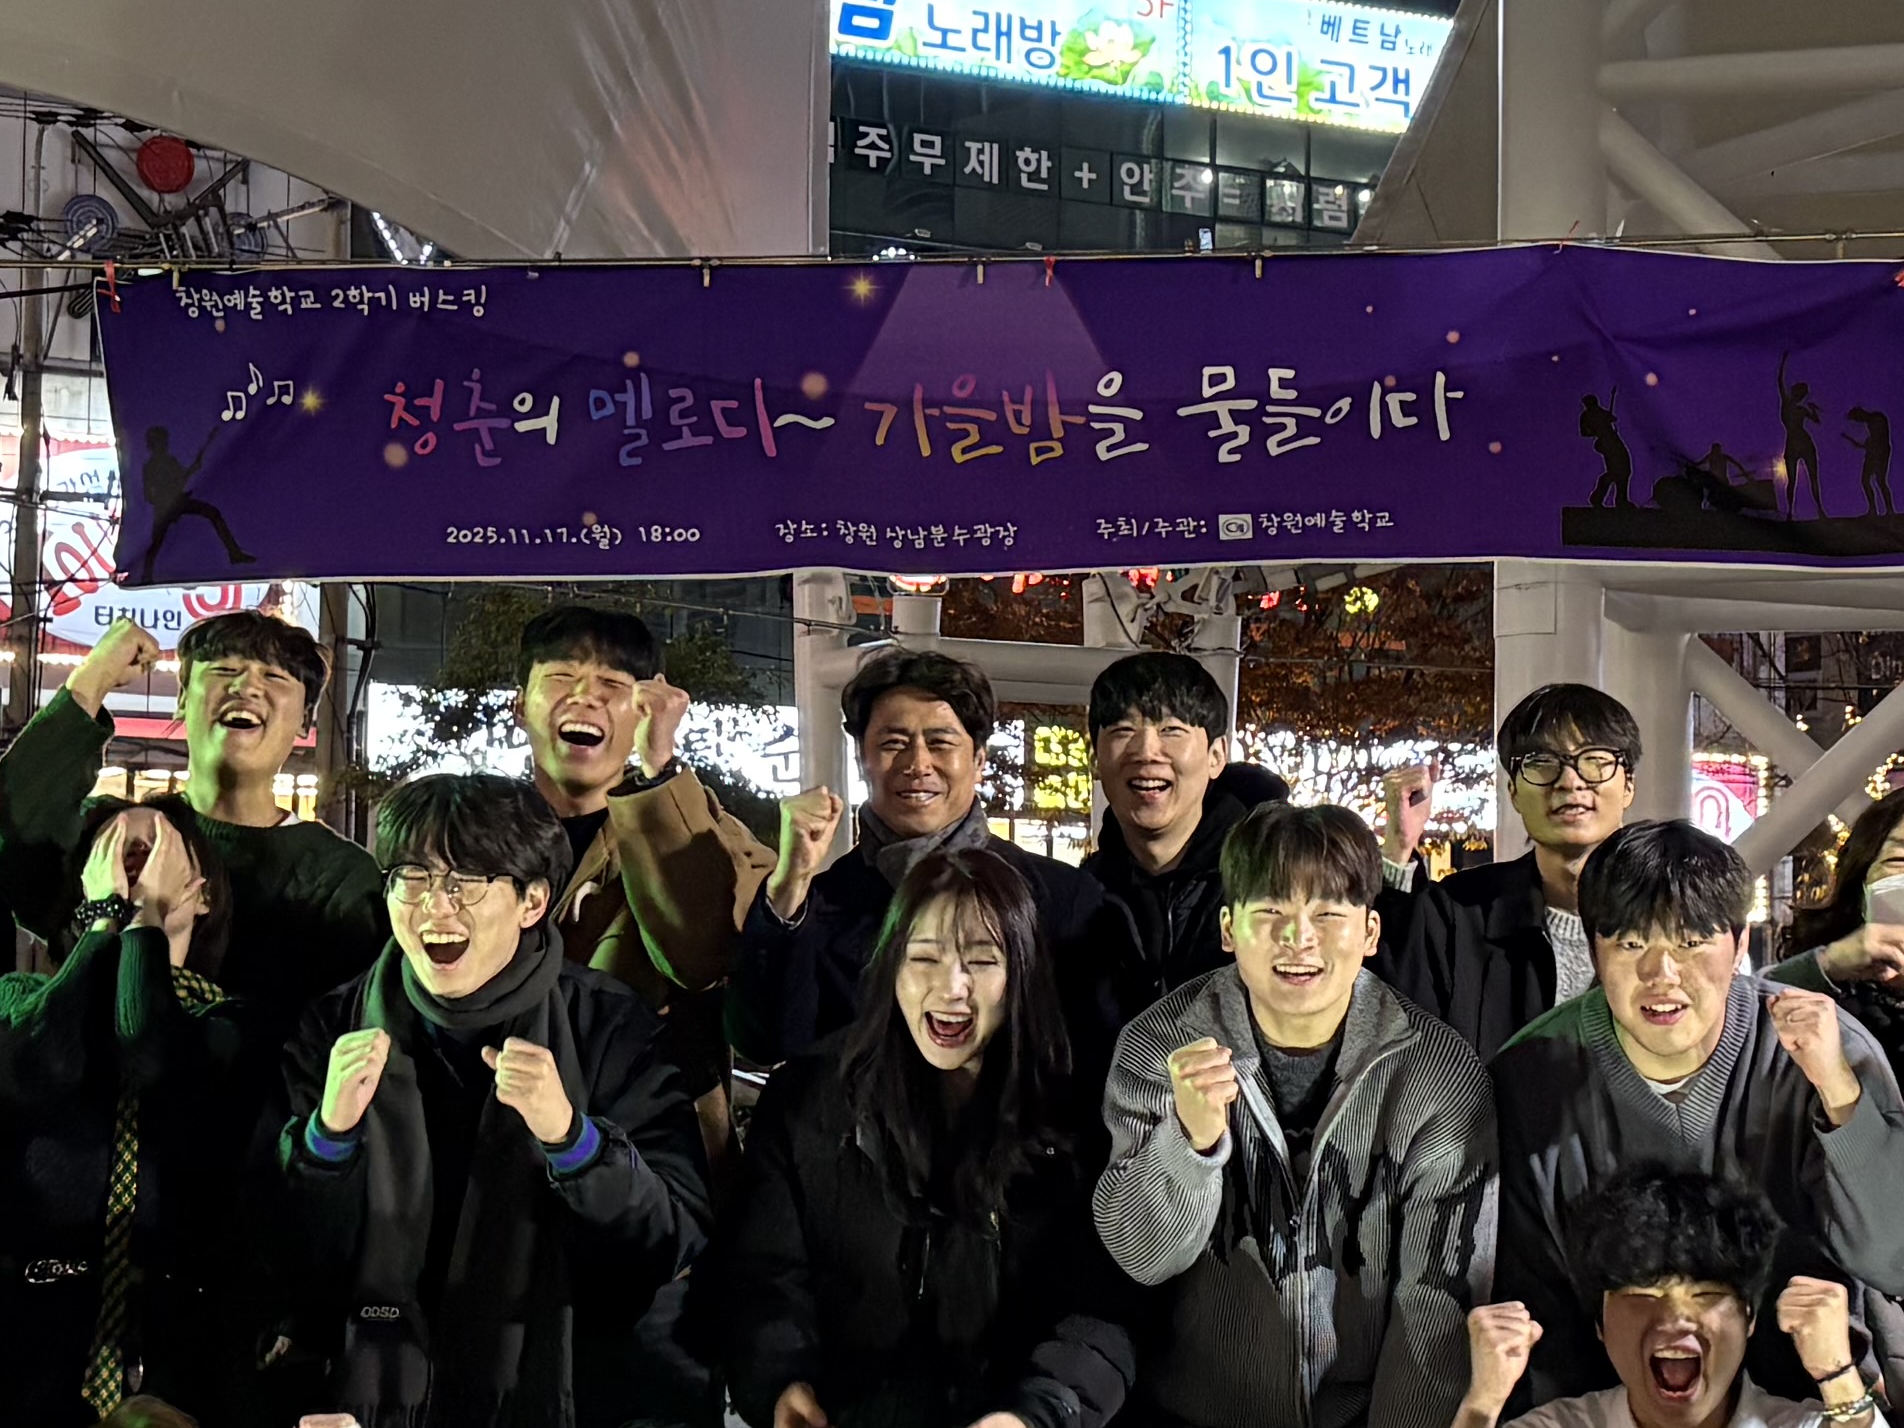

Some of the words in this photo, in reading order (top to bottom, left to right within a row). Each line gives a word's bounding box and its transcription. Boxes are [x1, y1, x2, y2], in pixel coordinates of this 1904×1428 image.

[922, 3, 1062, 70] 노래방
[1319, 13, 1402, 51] 베트남
[1217, 45, 1293, 103] 1인
[1314, 59, 1411, 118] 고객
[827, 122, 1052, 191] 주무제한
[1120, 161, 1206, 210] 안주
[175, 285, 322, 320] 창원예술학교
[331, 284, 397, 316] 2학기
[409, 285, 487, 317] 버스킹
[384, 368, 560, 467] 청춘의
[589, 372, 835, 467] 멜로디~
[864, 370, 1149, 465] 가을밤을
[1177, 365, 1465, 462] 물들이다
[446, 524, 622, 550] 2025.11.17.(월)
[639, 525, 700, 543] 18:00
[775, 520, 829, 543] 장소:
[836, 520, 877, 546] 창원
[886, 522, 1017, 549] 상남분수광장
[1096, 517, 1208, 539] 주최/주관:
[1258, 509, 1395, 536] 창원예술학교
